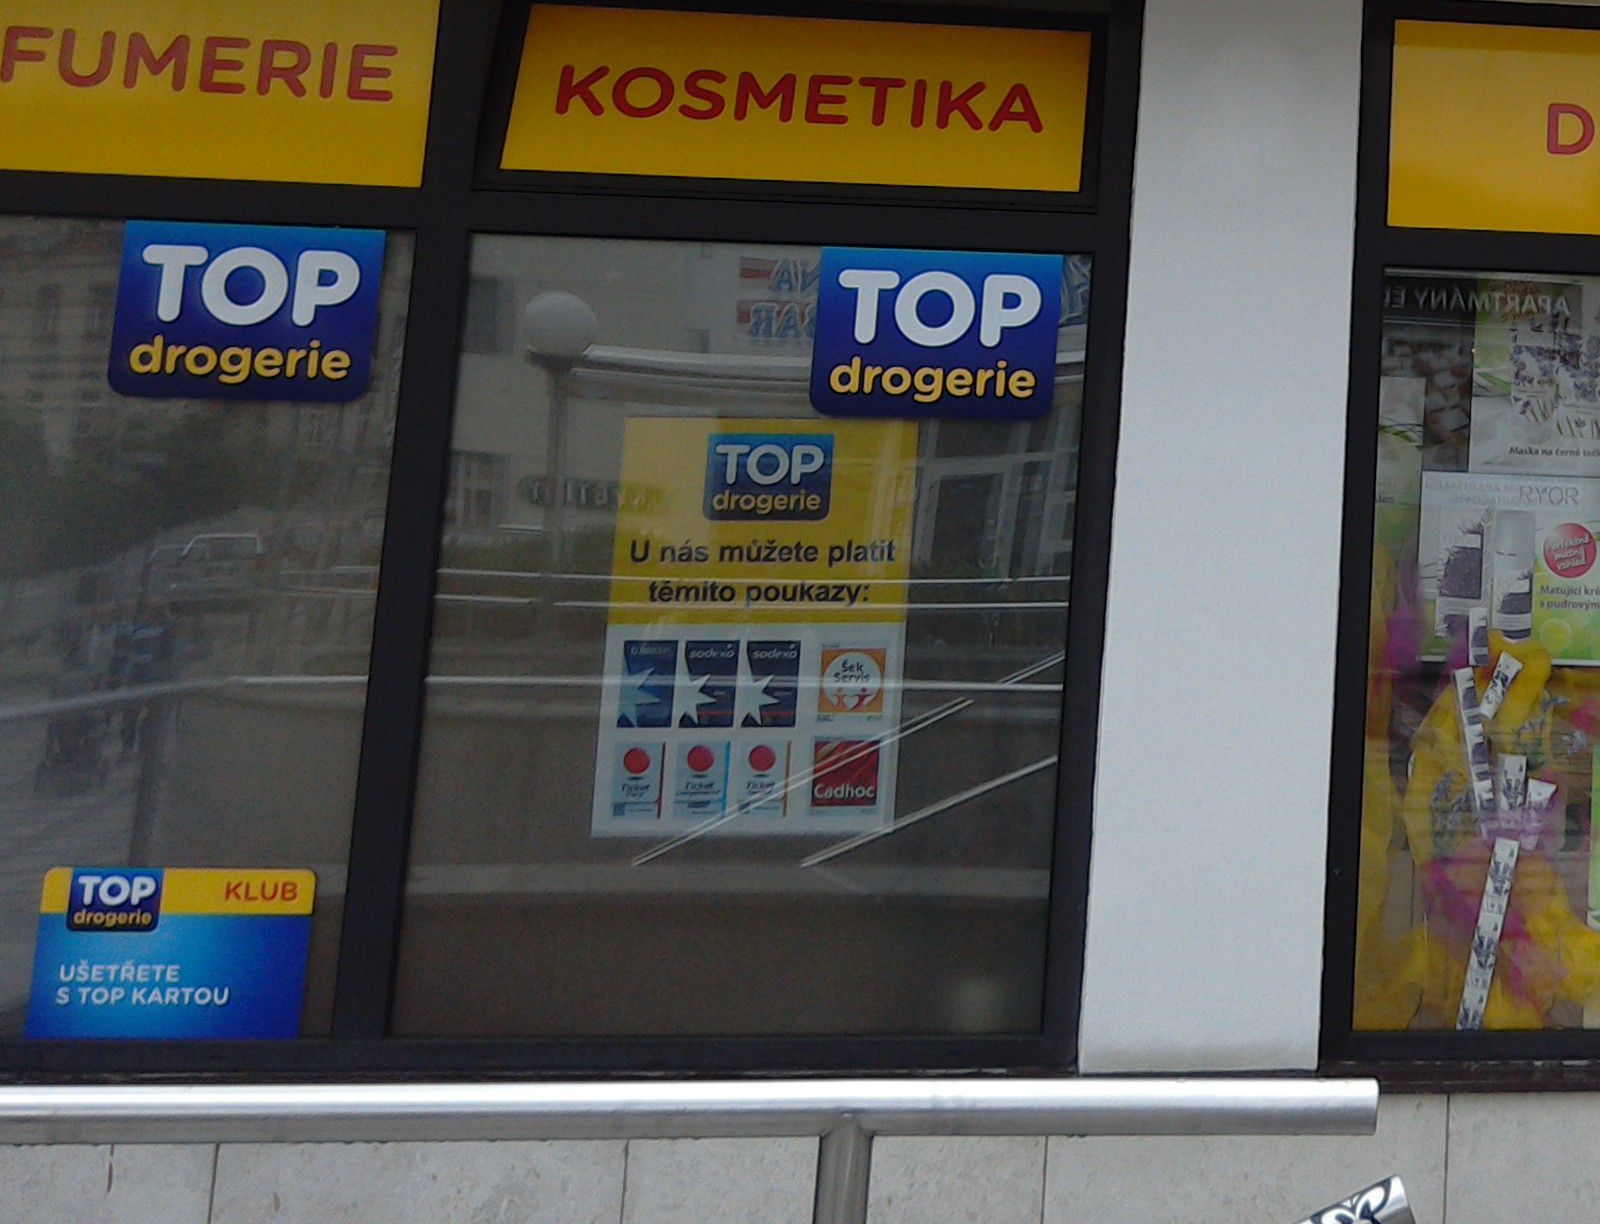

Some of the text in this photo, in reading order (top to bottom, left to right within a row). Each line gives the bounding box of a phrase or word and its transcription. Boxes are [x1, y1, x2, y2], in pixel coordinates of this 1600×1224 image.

[0, 25, 398, 102] FUMERIE
[555, 64, 1044, 134] KOSMETIKA
[142, 244, 360, 327] TOP
[837, 268, 1042, 348] TOP
[129, 334, 351, 385] drogerie
[829, 355, 1036, 404] drogerie
[715, 444, 825, 486] TOP
[712, 490, 822, 515] drogerie
[1519, 485, 1579, 507] RYOR
[630, 538, 895, 568] U nás můžete platit
[649, 580, 737, 603] těmito
[813, 782, 876, 801] Cadhoc
[78, 875, 156, 907] TOP
[225, 880, 299, 902] KLUB
[73, 907, 153, 927] drogerie
[59, 960, 181, 984] UŠETŘETE
[56, 986, 230, 1006] S TOP KARTOU
